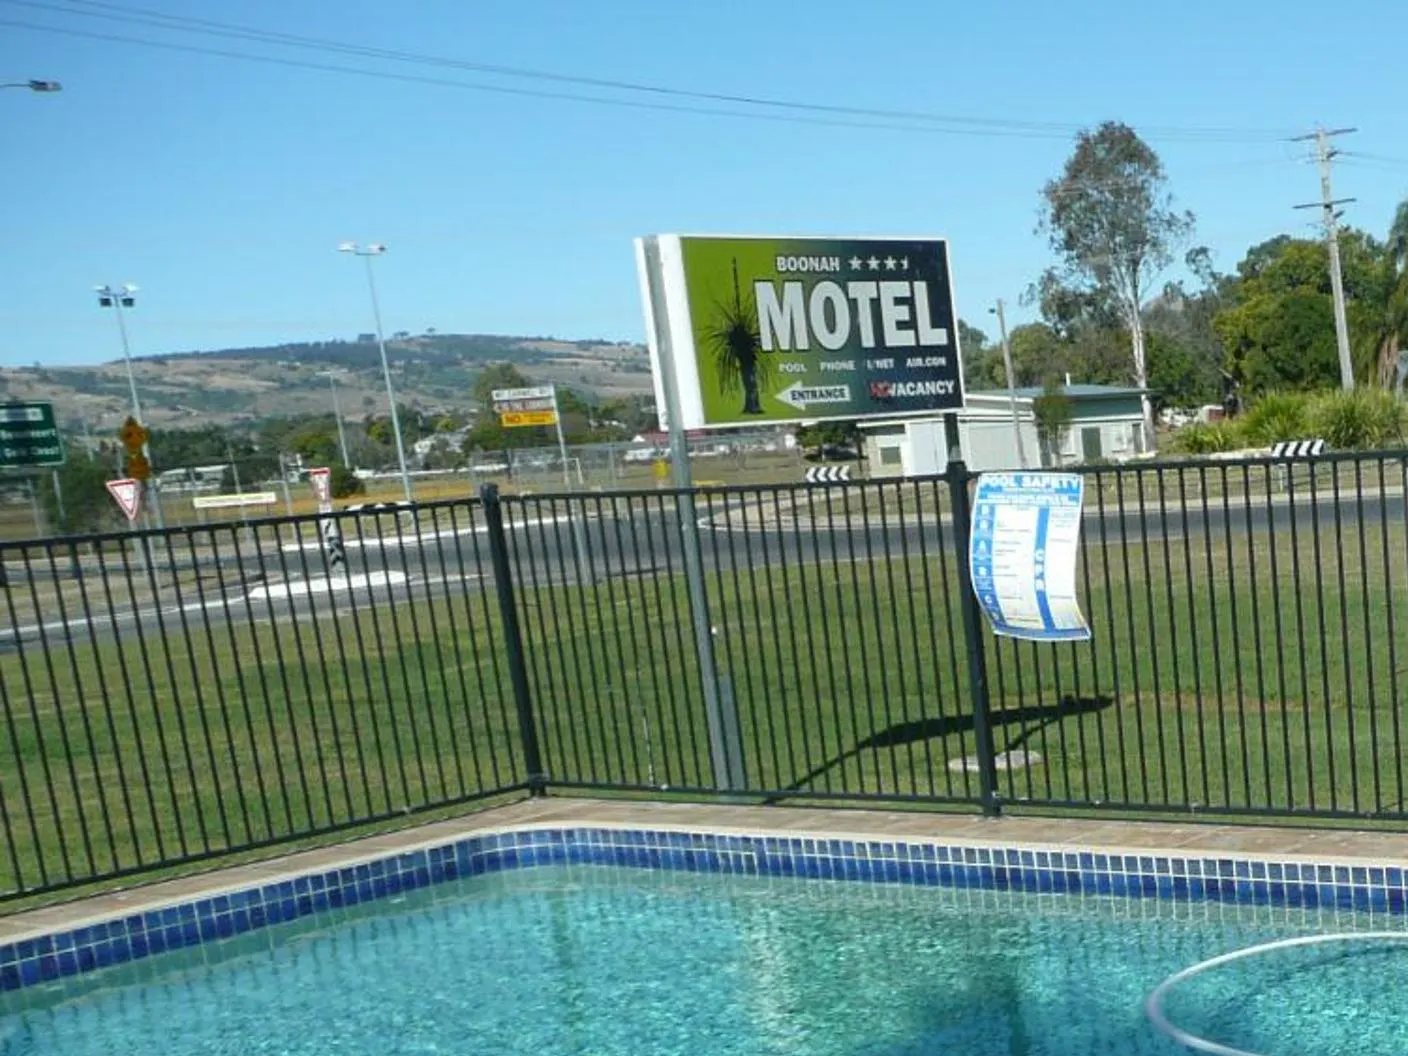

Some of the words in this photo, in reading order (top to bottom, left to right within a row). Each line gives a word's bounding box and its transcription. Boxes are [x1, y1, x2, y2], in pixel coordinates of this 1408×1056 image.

[776, 256, 840, 272] BOONAH
[754, 280, 949, 351] MOTEL
[779, 362, 808, 373] POOL
[820, 360, 856, 371] PHONE
[790, 387, 847, 401] ENTRANCE
[887, 380, 955, 397] VACANCY
[981, 475, 1015, 488] POOL
[1021, 475, 1080, 488] SAFETY
